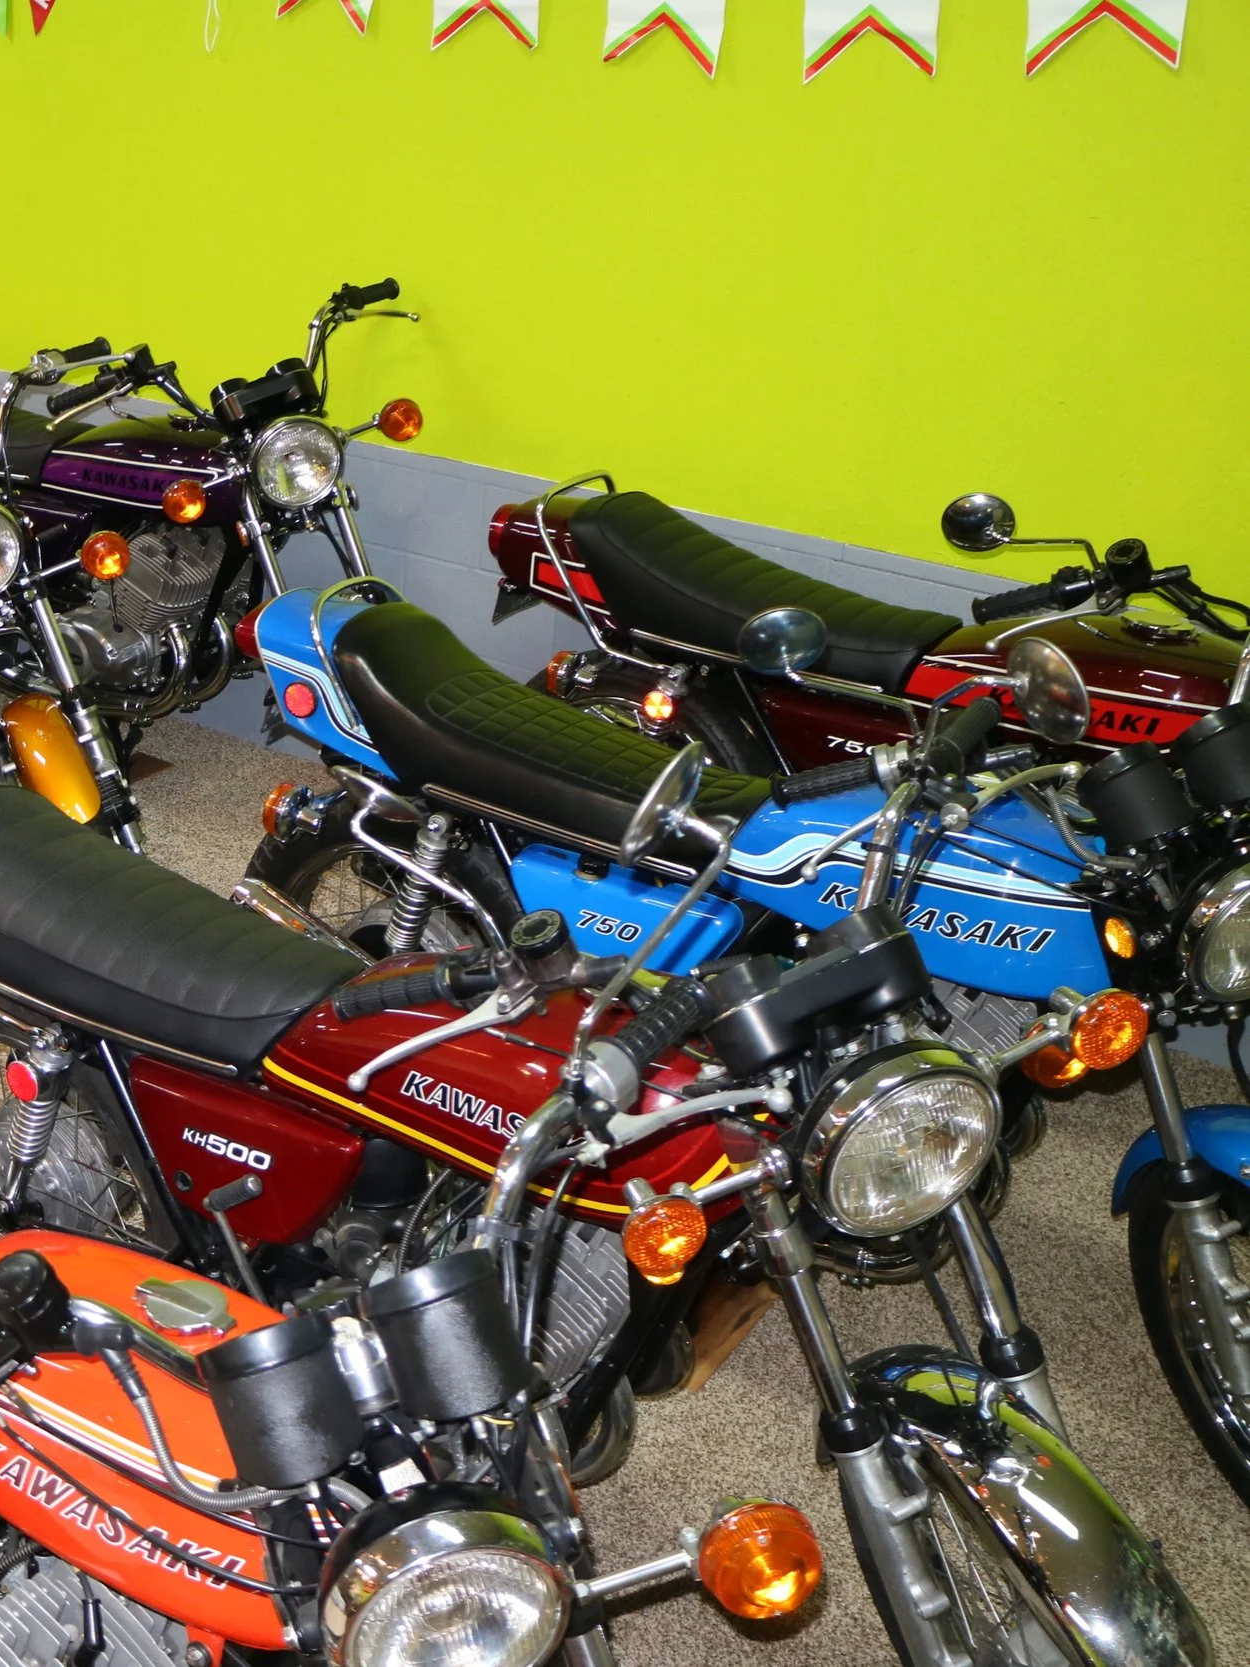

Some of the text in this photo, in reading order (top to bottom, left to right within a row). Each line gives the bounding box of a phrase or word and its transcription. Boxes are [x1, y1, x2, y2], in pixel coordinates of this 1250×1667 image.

[82, 467, 166, 494] KAWASAK
[576, 910, 642, 943] 750
[817, 882, 1056, 955] KASAKI
[182, 1127, 272, 1171] KH500
